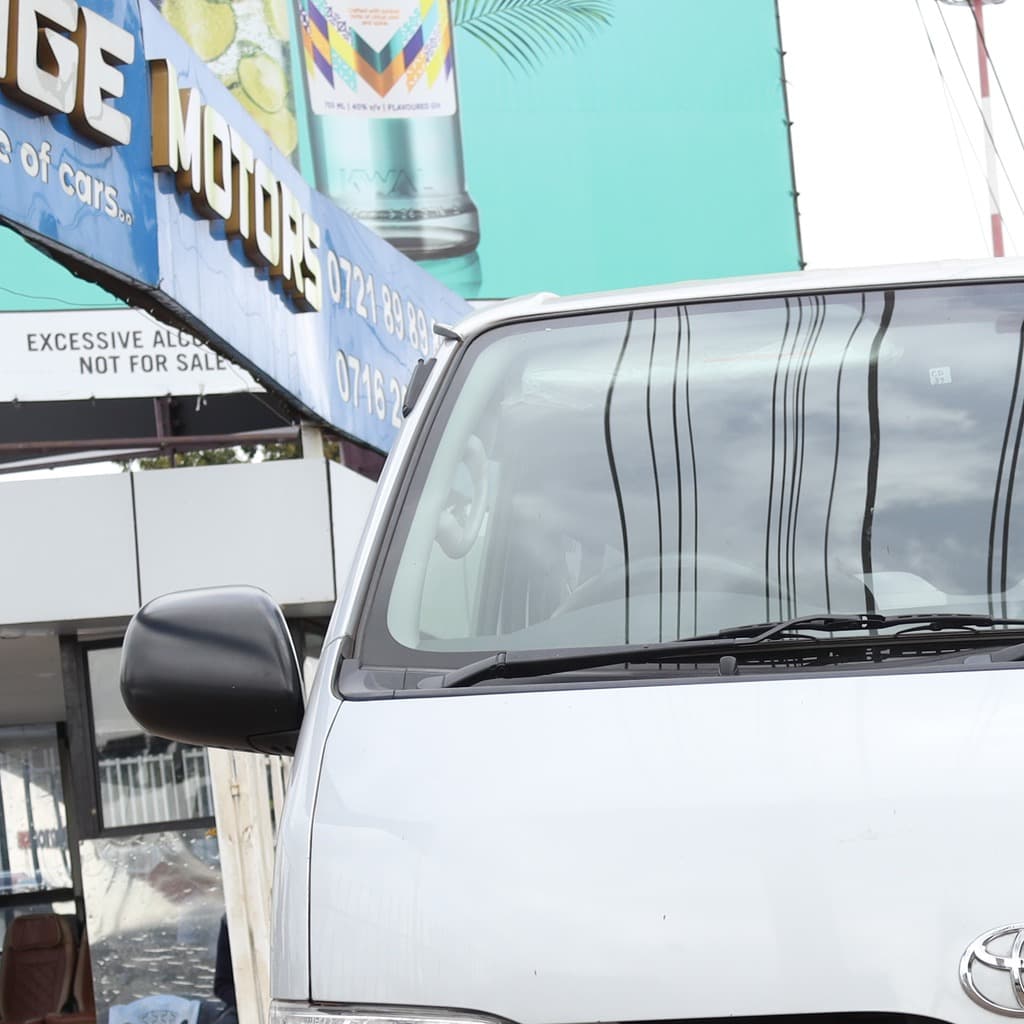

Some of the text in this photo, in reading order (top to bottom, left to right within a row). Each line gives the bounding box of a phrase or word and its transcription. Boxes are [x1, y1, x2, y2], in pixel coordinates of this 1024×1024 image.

[0, 0, 135, 146] GE
[20, 140, 51, 184] of
[152, 58, 323, 313] MOTORS
[327, 250, 378, 324] 0721
[382, 284, 405, 341] 89
[407, 301, 429, 356] 89
[27, 330, 144, 351] EXCESSIVE
[79, 353, 227, 374] NOT FOR SALE
[336, 349, 387, 420] 0716
